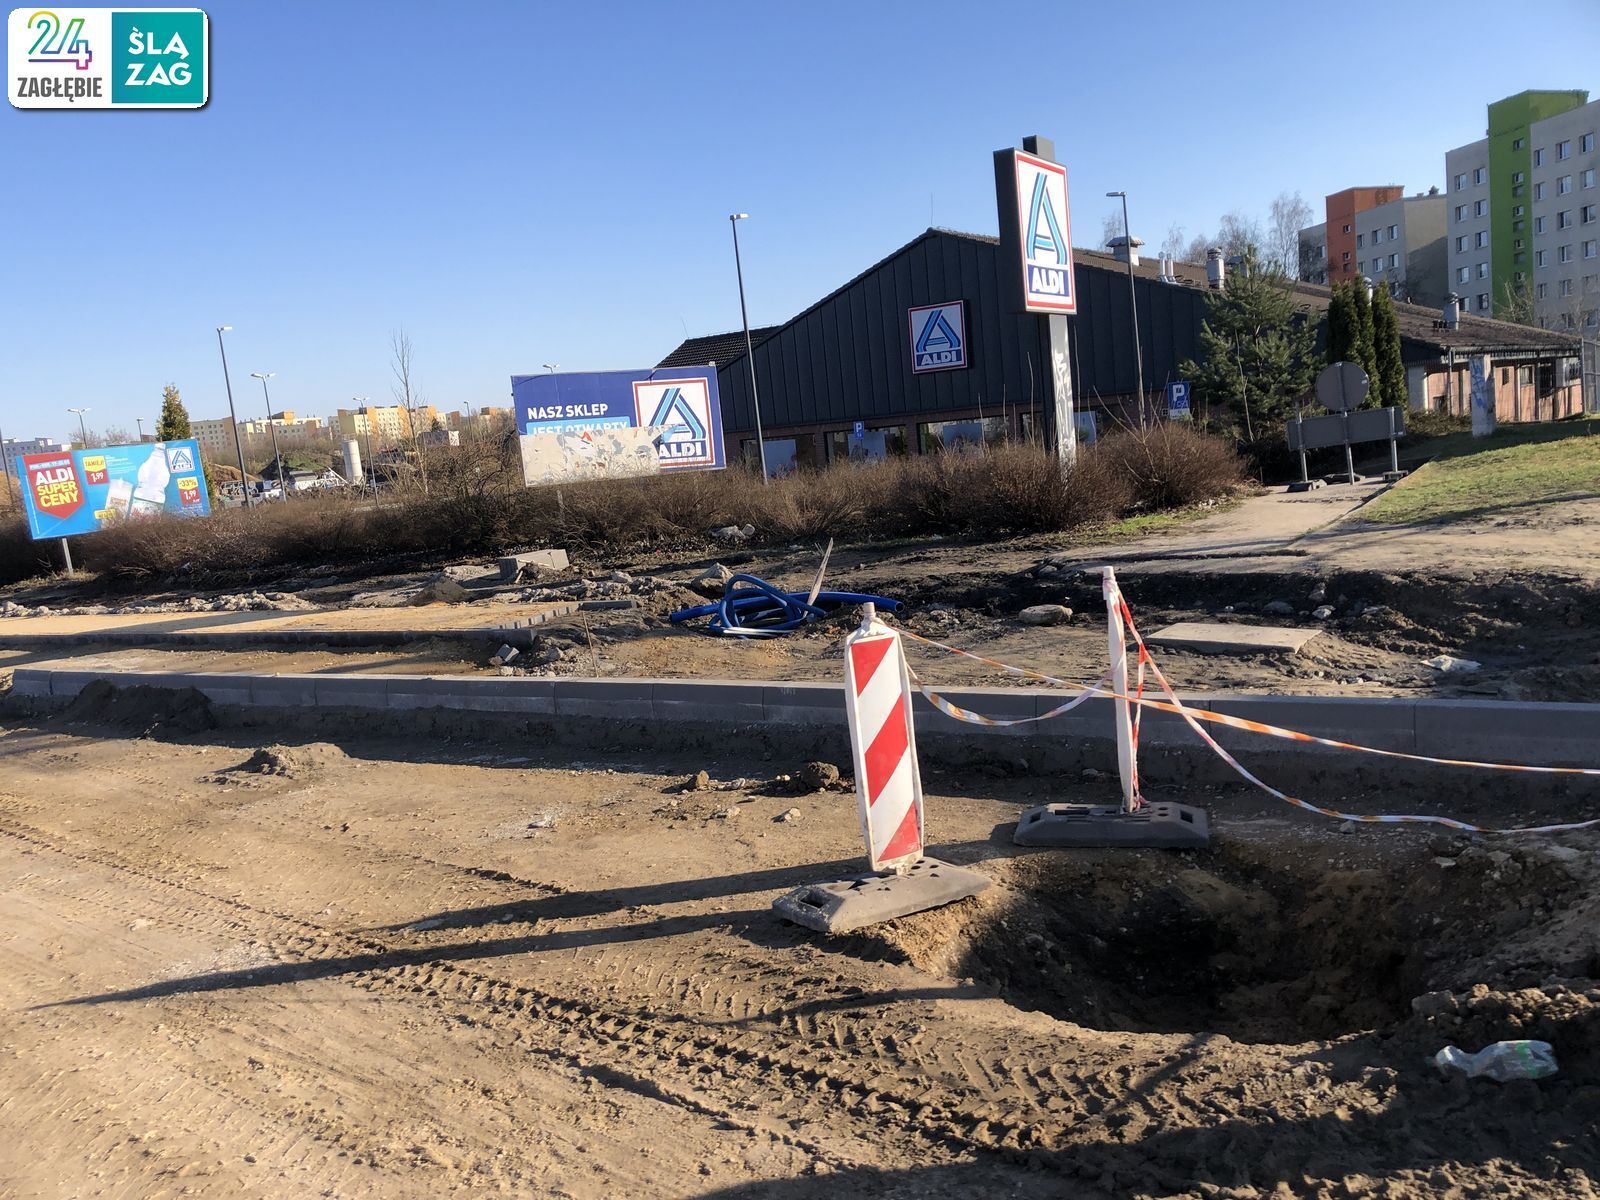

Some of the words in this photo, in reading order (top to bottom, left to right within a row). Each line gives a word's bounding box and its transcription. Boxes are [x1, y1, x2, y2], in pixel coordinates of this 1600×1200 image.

[1031, 267, 1066, 294] ALDI
[920, 350, 958, 366] ALDI
[1172, 384, 1185, 401] P
[527, 406, 564, 420] NASZ
[565, 403, 609, 417] SKLEP
[855, 422, 863, 432] P
[659, 441, 703, 458] ALDI
[36, 467, 75, 486] ALDI
[37, 481, 77, 496] SUPER
[40, 490, 79, 508] CENY
